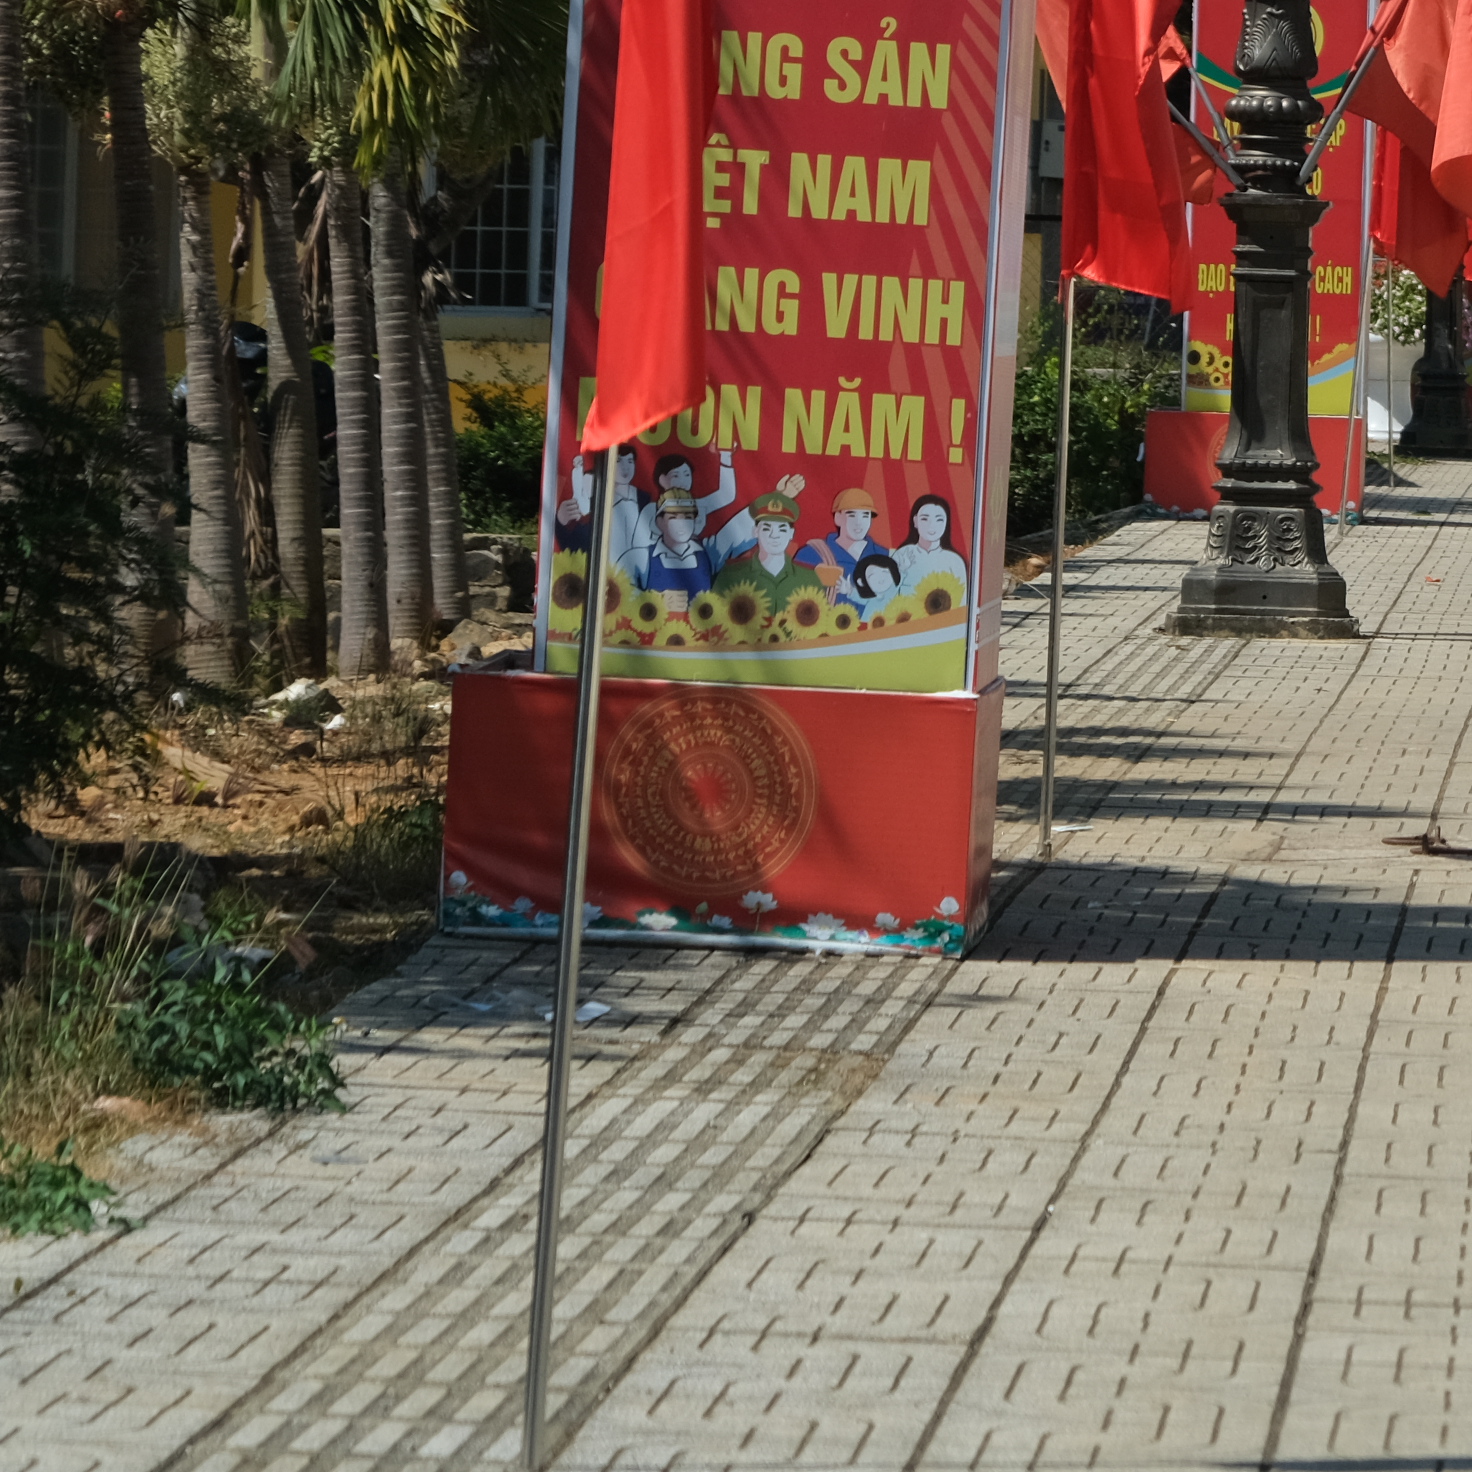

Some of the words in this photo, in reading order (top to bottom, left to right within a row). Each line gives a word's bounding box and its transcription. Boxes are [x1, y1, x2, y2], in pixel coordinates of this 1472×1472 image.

[718, 30, 804, 101] NG
[823, 16, 951, 110] SẢN
[702, 132, 770, 228] ỆT
[787, 151, 932, 226] NAM
[822, 272, 965, 346] VINH
[1198, 263, 1226, 298] ĐẠO
[1315, 260, 1352, 295] CÁCH
[781, 376, 925, 462] NĂM
